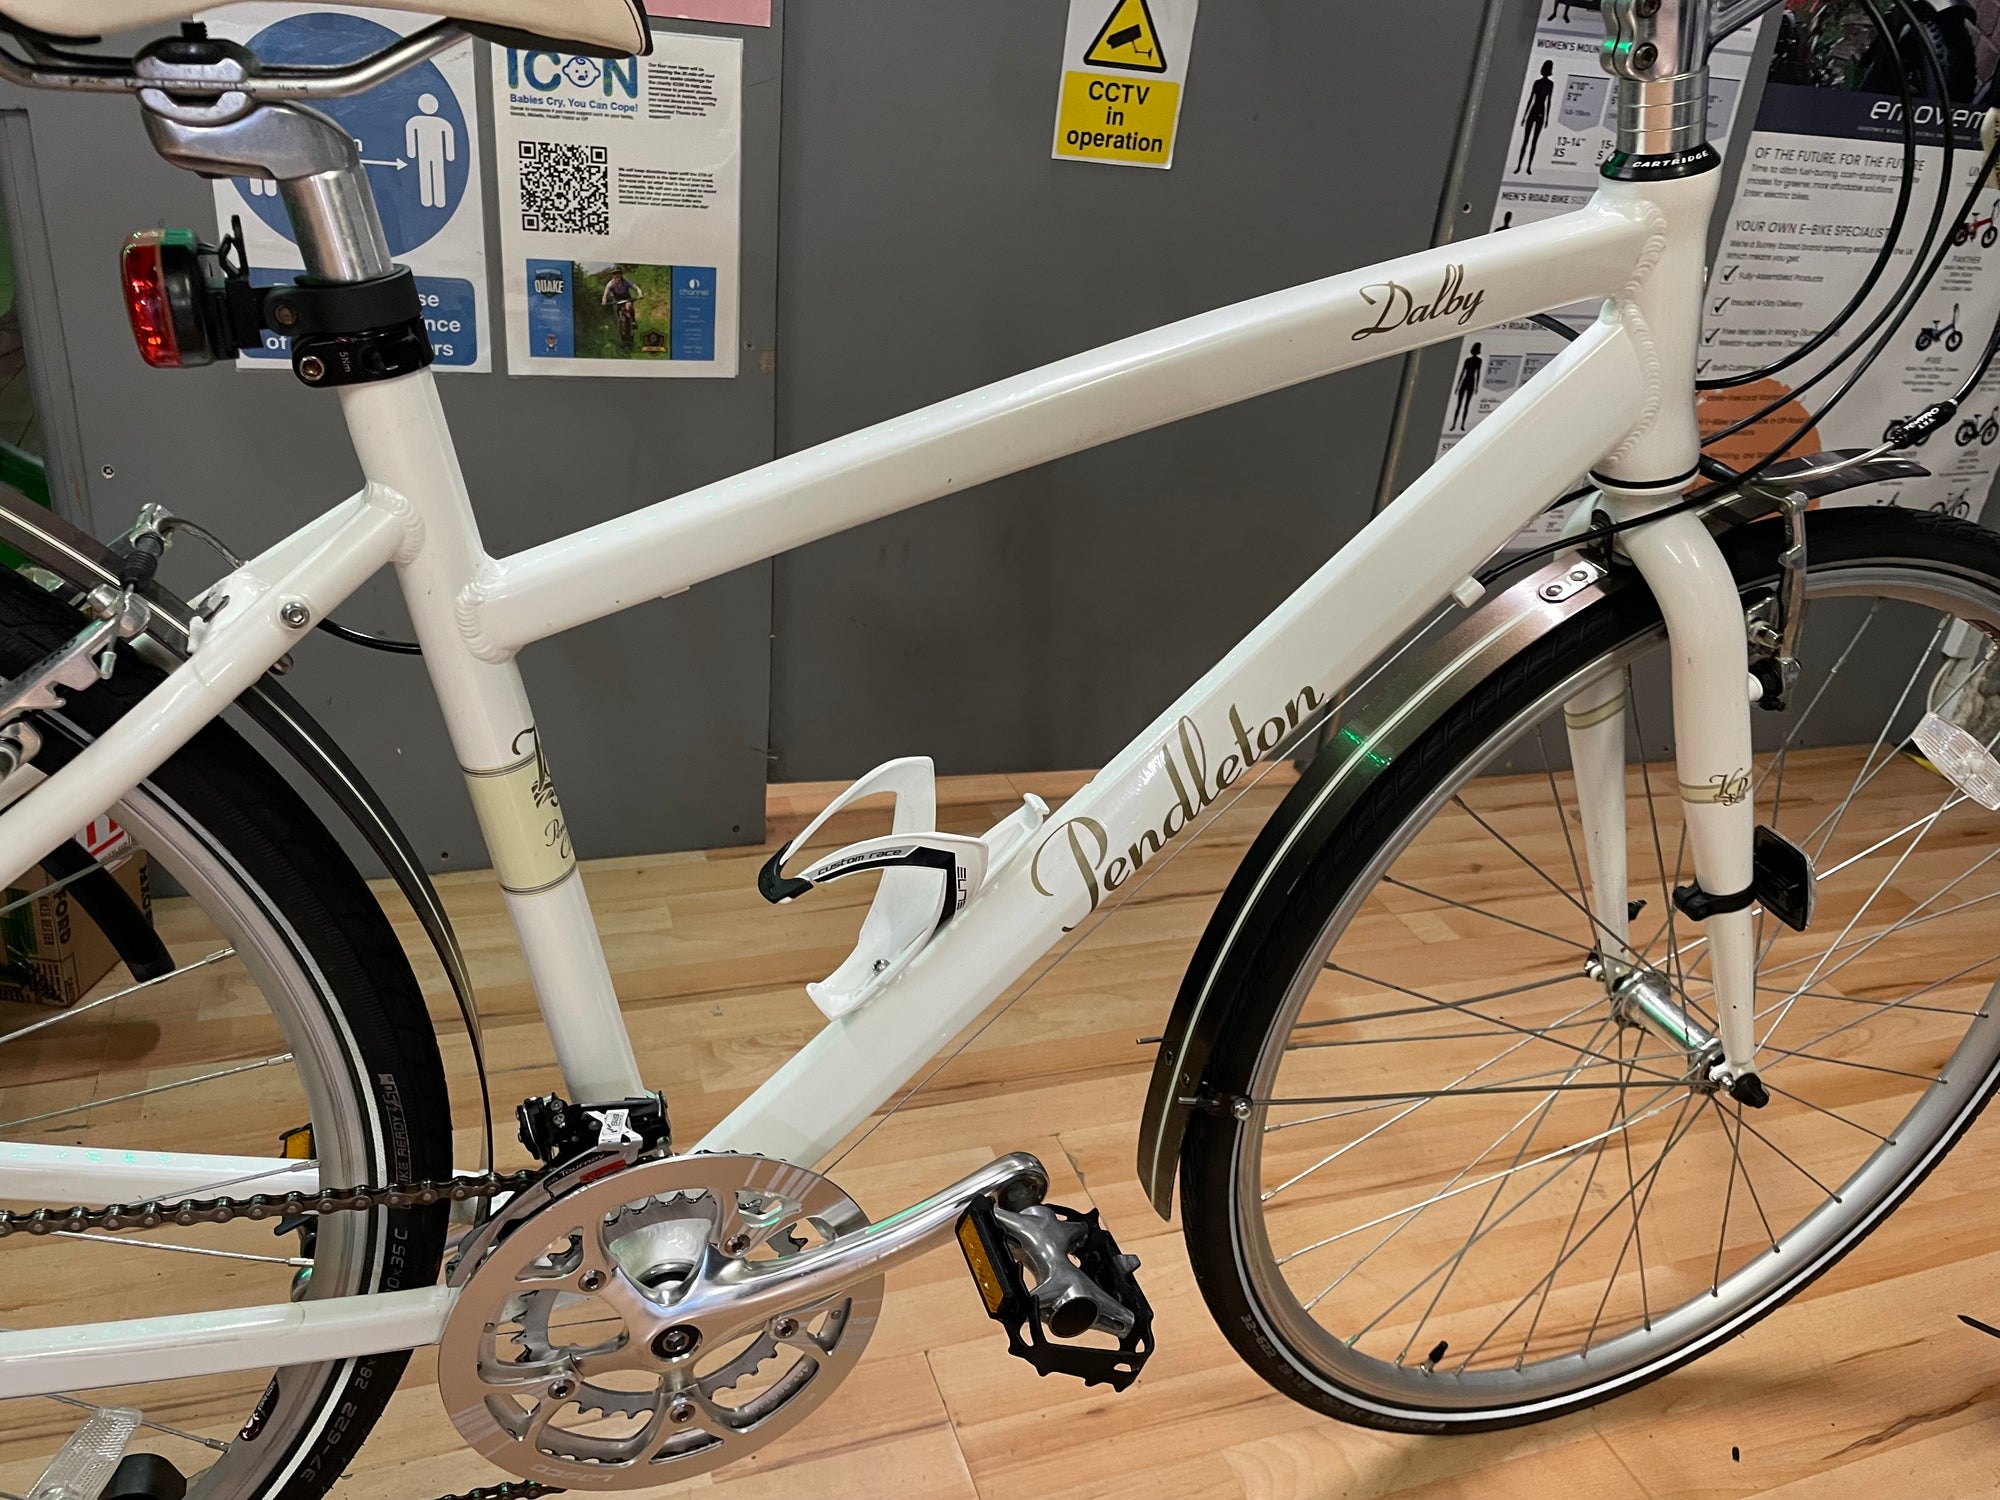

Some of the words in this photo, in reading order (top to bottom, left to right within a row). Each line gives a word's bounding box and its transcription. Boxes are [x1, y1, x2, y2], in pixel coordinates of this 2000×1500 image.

[1537, 38, 1575, 51] WOMEN'S
[1576, 42, 1601, 54] MOUN
[510, 94, 544, 104] Babies
[546, 97, 566, 107] Cry,
[568, 99, 586, 107] You
[589, 100, 607, 109] Can
[611, 102, 638, 112] Cope!
[1088, 80, 1150, 105] CCTV
[1106, 106, 1124, 126] in
[1870, 101, 1987, 129] emovem
[1066, 129, 1163, 153] operation
[1600, 139, 1615, 150] 15-
[1553, 147, 1566, 158] XS
[1632, 150, 1709, 168] CARTRIDGE
[1755, 147, 1771, 158] OF
[1775, 149, 1795, 160] THE
[1797, 150, 1837, 164] FUTURE,
[1839, 154, 1860, 165] FOR
[1865, 156, 1884, 168] THE
[1886, 158, 1926, 171] FUTRE
[1502, 192, 1527, 201] MEN'S
[1527, 193, 1551, 203] ROAD
[1551, 194, 1570, 204] BIKE
[1736, 220, 1765, 232] YOUR
[1768, 222, 1797, 233] OWN
[1799, 223, 1833, 235] E-BIKE
[534, 279, 564, 295] QUAKE
[1351, 263, 1485, 341] Dalby
[339, 351, 351, 372] 5Nm
[1030, 685, 1325, 933] Pendleton
[817, 854, 865, 876] custom
[869, 849, 902, 860] race
[559, 1153, 605, 1177] Tourney
[1240, 1314, 1277, 1359] 32-622
[300, 1401, 358, 1483] 37-622
[355, 1358, 377, 1390] 28x
